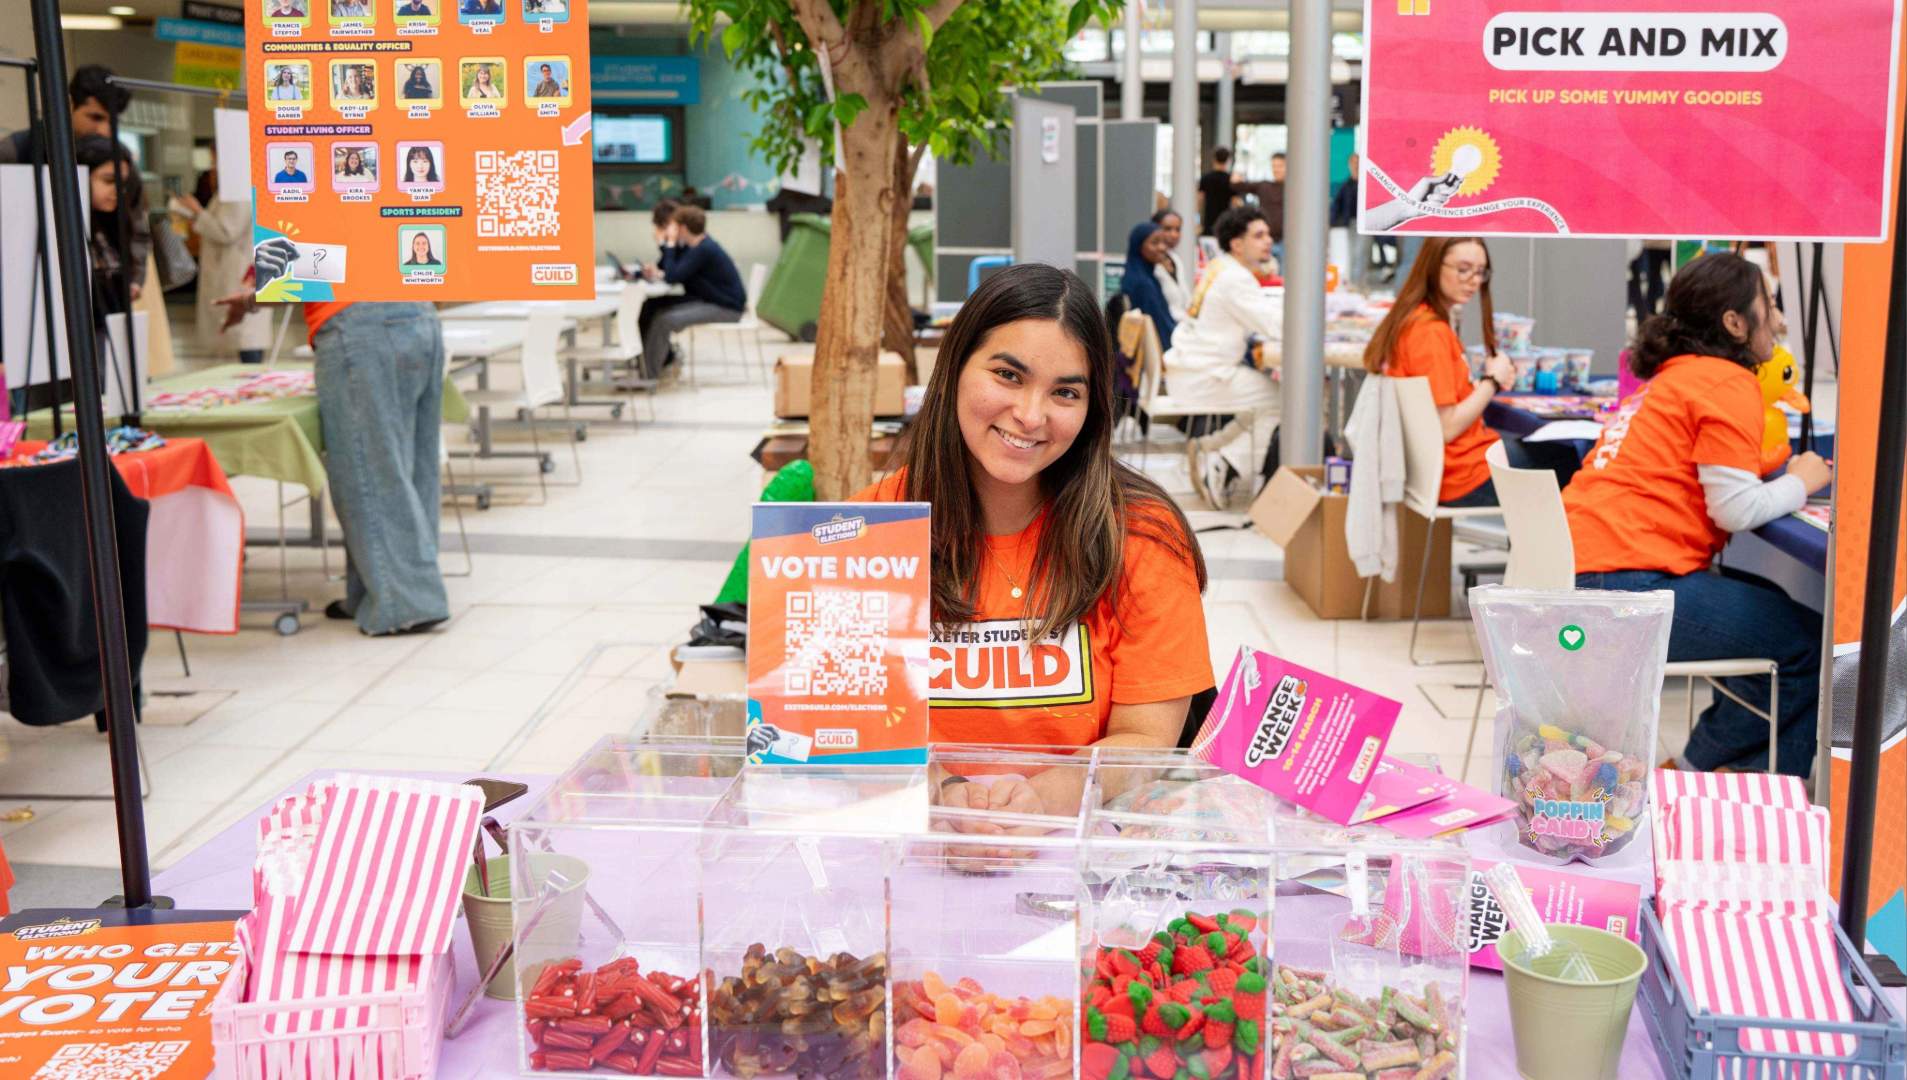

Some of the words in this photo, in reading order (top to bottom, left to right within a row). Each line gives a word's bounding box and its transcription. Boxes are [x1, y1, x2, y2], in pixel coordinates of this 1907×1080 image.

[264, 43, 323, 52] COMMUNITIES
[325, 43, 331, 51] &
[333, 42, 374, 51] EQUALITY
[375, 42, 411, 51] OFFICER
[1493, 27, 1585, 56] PICK
[1598, 27, 1687, 56] AND
[1701, 28, 1778, 57] MIX
[1489, 89, 1528, 104] PICK
[1532, 90, 1556, 104] UP
[1560, 90, 1608, 104] SOME
[1613, 90, 1680, 105] YUMMY
[1683, 90, 1763, 105] GOODIES
[266, 126, 304, 135] STUDENT
[305, 126, 335, 135] LIVING
[336, 125, 371, 134] OFFICER
[1370, 167, 1398, 193] CHANGE
[1398, 192, 1418, 208] YOUR
[1417, 203, 1465, 216] EXPERIENCE
[1466, 203, 1500, 216] CHANGE
[1502, 199, 1525, 210] YOUR
[1526, 199, 1566, 230] EXPERIENCE
[381, 208, 415, 217] SPORTS
[416, 207, 461, 216] PRESIDENT
[534, 270, 574, 281] GUILD
[814, 519, 862, 537] STUDENT
[820, 530, 857, 544] ELECTIONS
[760, 556, 838, 580] VOTE
[845, 556, 920, 580] NOW
[930, 631, 980, 643] XETER
[983, 629, 1059, 643] STUDES
[929, 643, 1071, 690] GUILD
[1249, 679, 1295, 763] CHANGE
[1264, 699, 1302, 755] WEEK
[1298, 697, 1323, 742] MARCH
[817, 735, 855, 745] GUILD
[1317, 762, 1325, 773] the
[1336, 698, 1354, 736] experience
[1297, 768, 1314, 794] Change
[1325, 728, 1334, 742] your
[1332, 701, 1345, 726] chance
[1335, 742, 1344, 756] and
[1534, 798, 1604, 820] POPPIN
[1531, 816, 1605, 839] CANDY
[1469, 874, 1487, 949] CHANGE
[17, 921, 98, 936] STUDENT
[19, 929, 81, 940] ELECTIONS
[24, 943, 135, 961] WHO
[2, 960, 232, 992] YOUR
